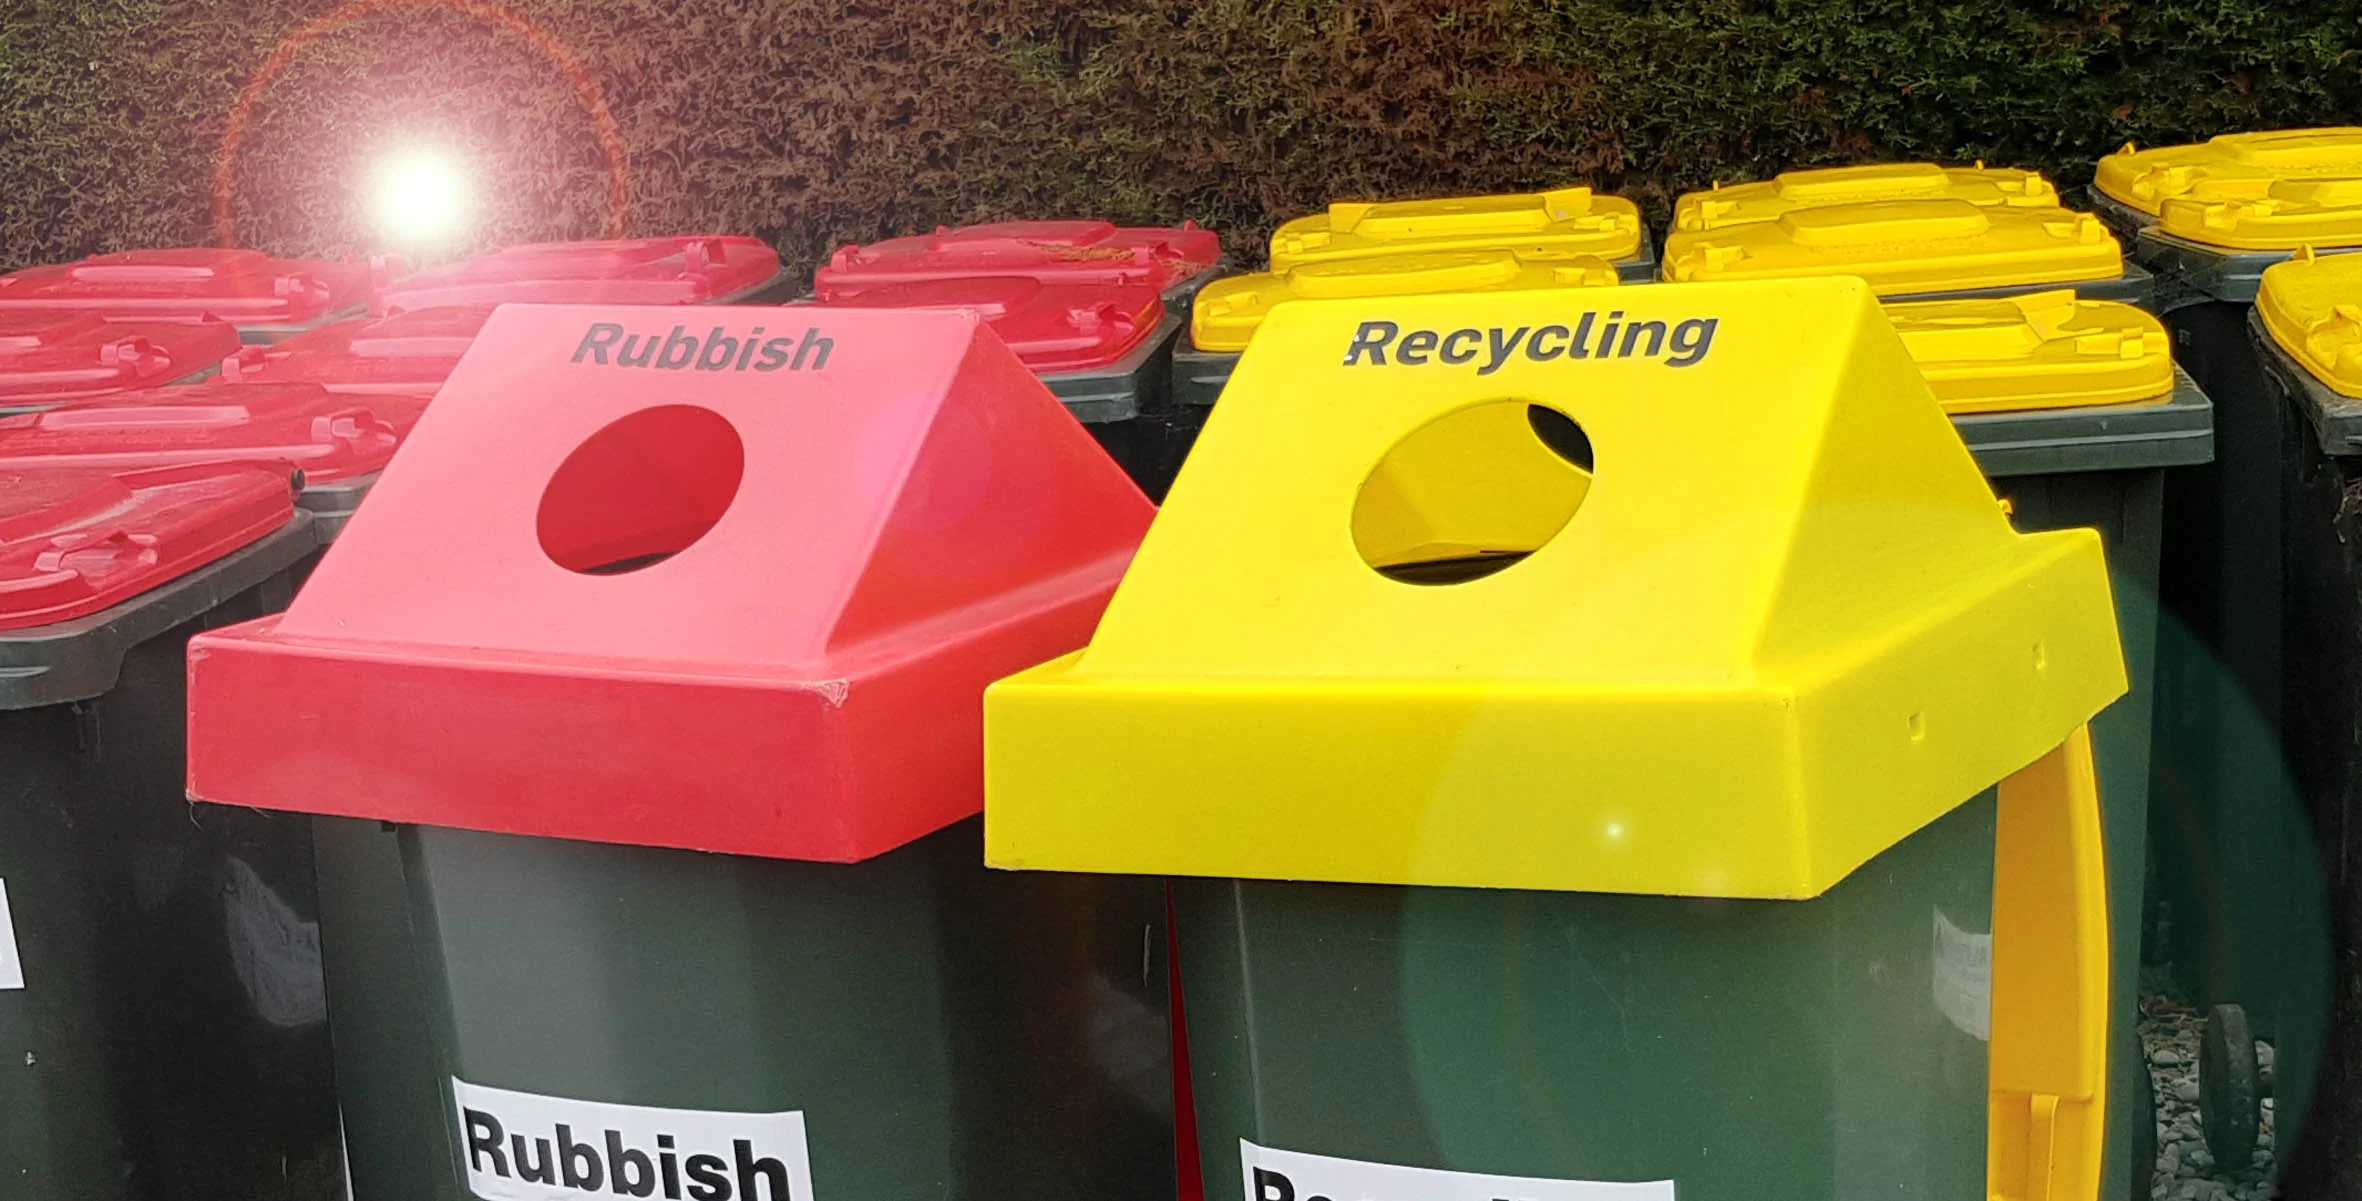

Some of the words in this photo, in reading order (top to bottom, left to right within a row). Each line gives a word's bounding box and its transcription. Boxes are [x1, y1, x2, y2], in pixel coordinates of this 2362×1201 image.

[571, 323, 834, 371] Rubbish
[1343, 311, 1718, 375] Recycling
[463, 1107, 791, 1201] Rubbish
